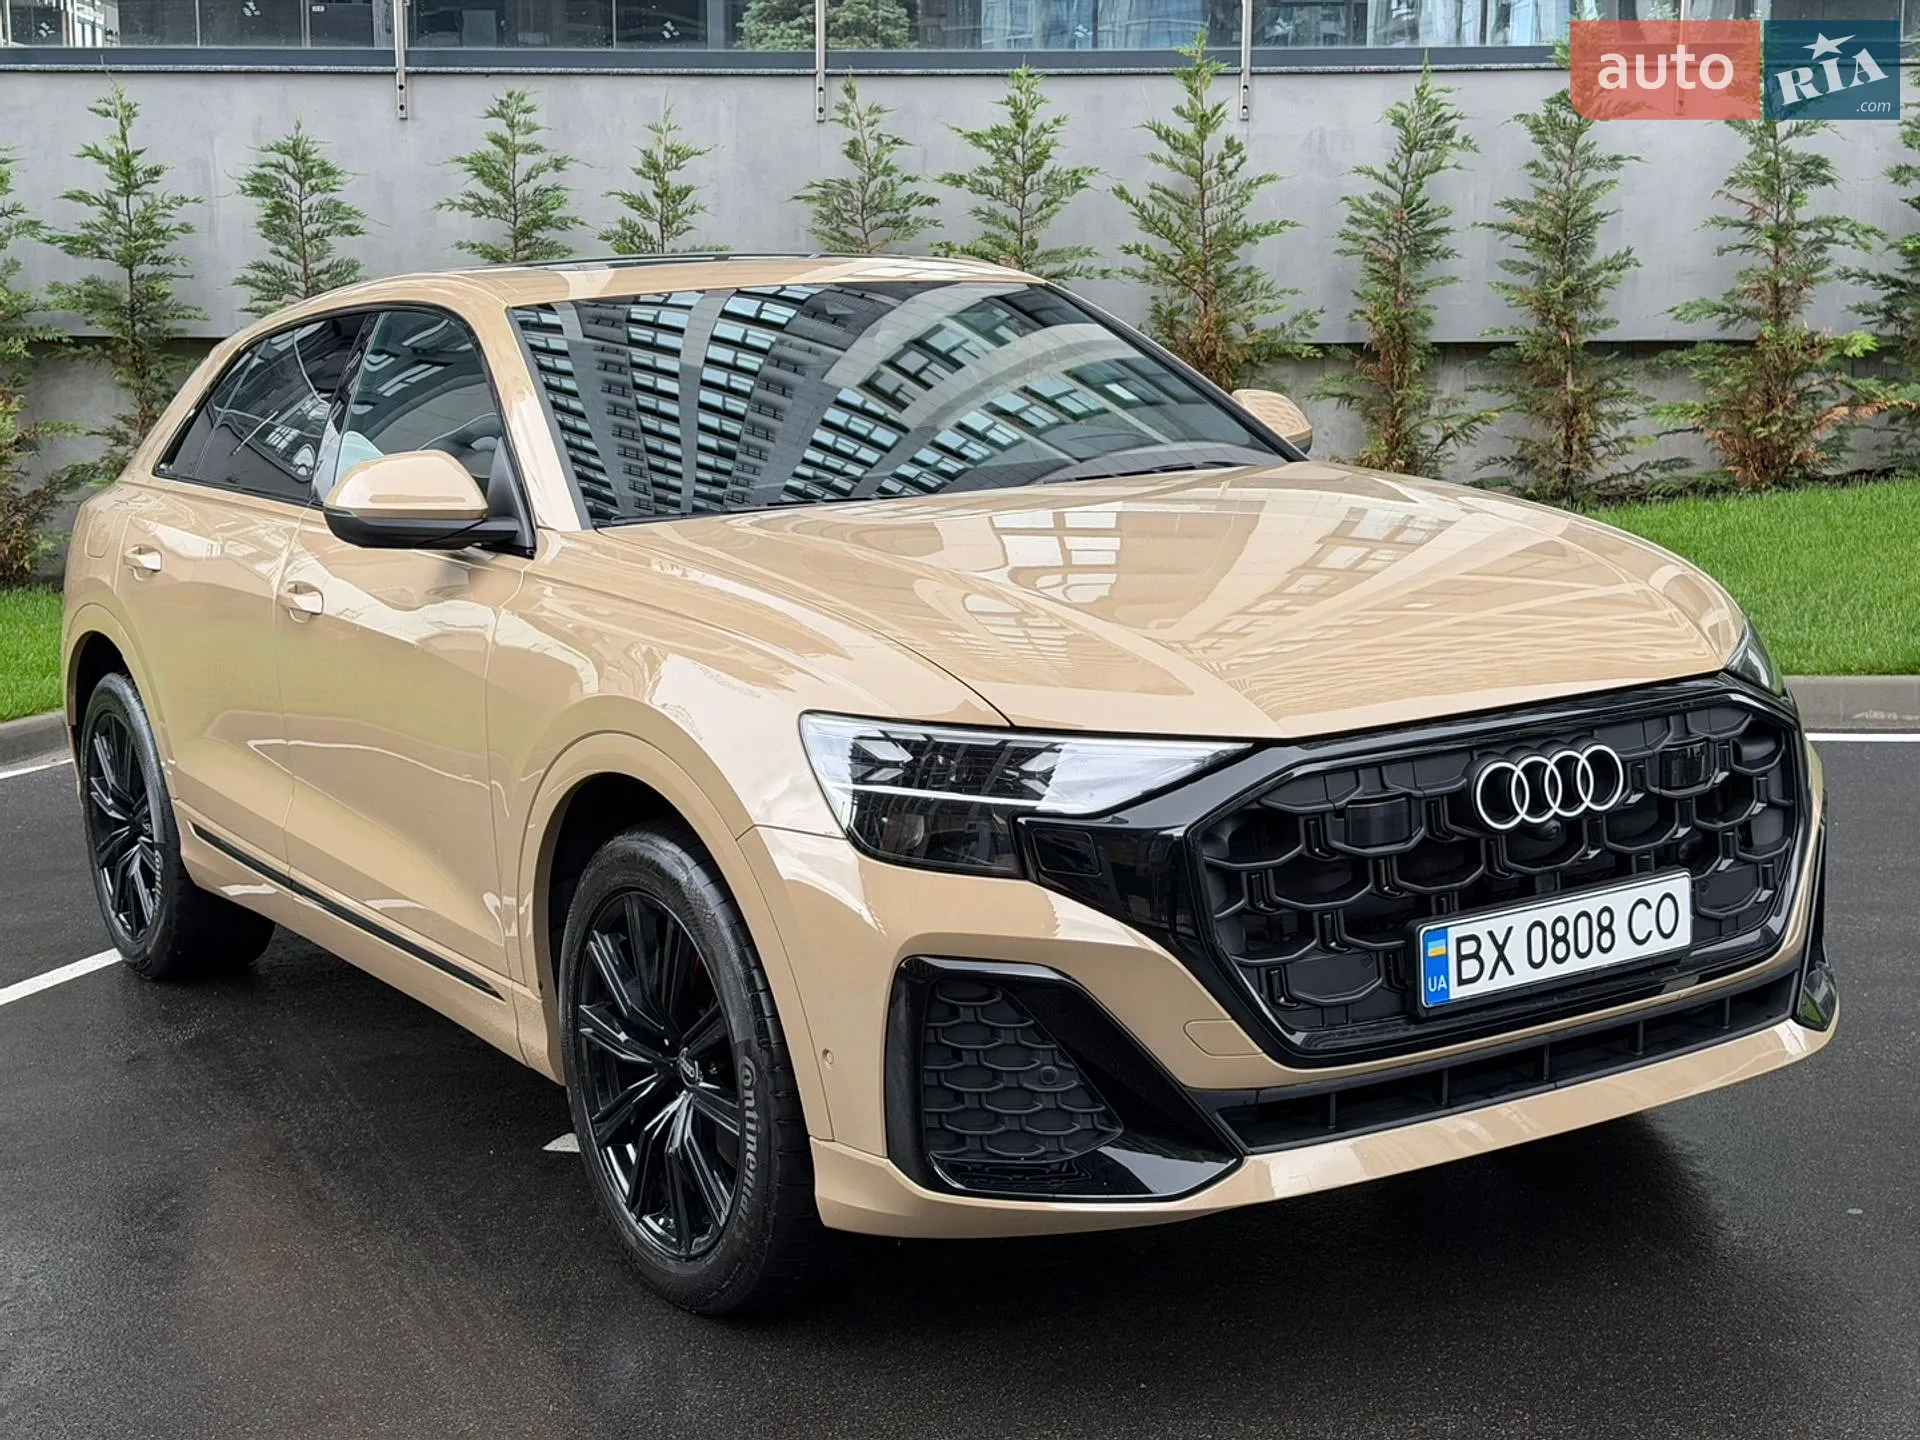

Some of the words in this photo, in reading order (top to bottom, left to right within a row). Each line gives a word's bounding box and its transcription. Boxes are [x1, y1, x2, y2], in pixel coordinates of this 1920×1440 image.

[1456, 925, 1515, 986] BX
[1527, 905, 1616, 970] 0808
[1628, 892, 1679, 946] CO
[1428, 975, 1447, 992] UA
